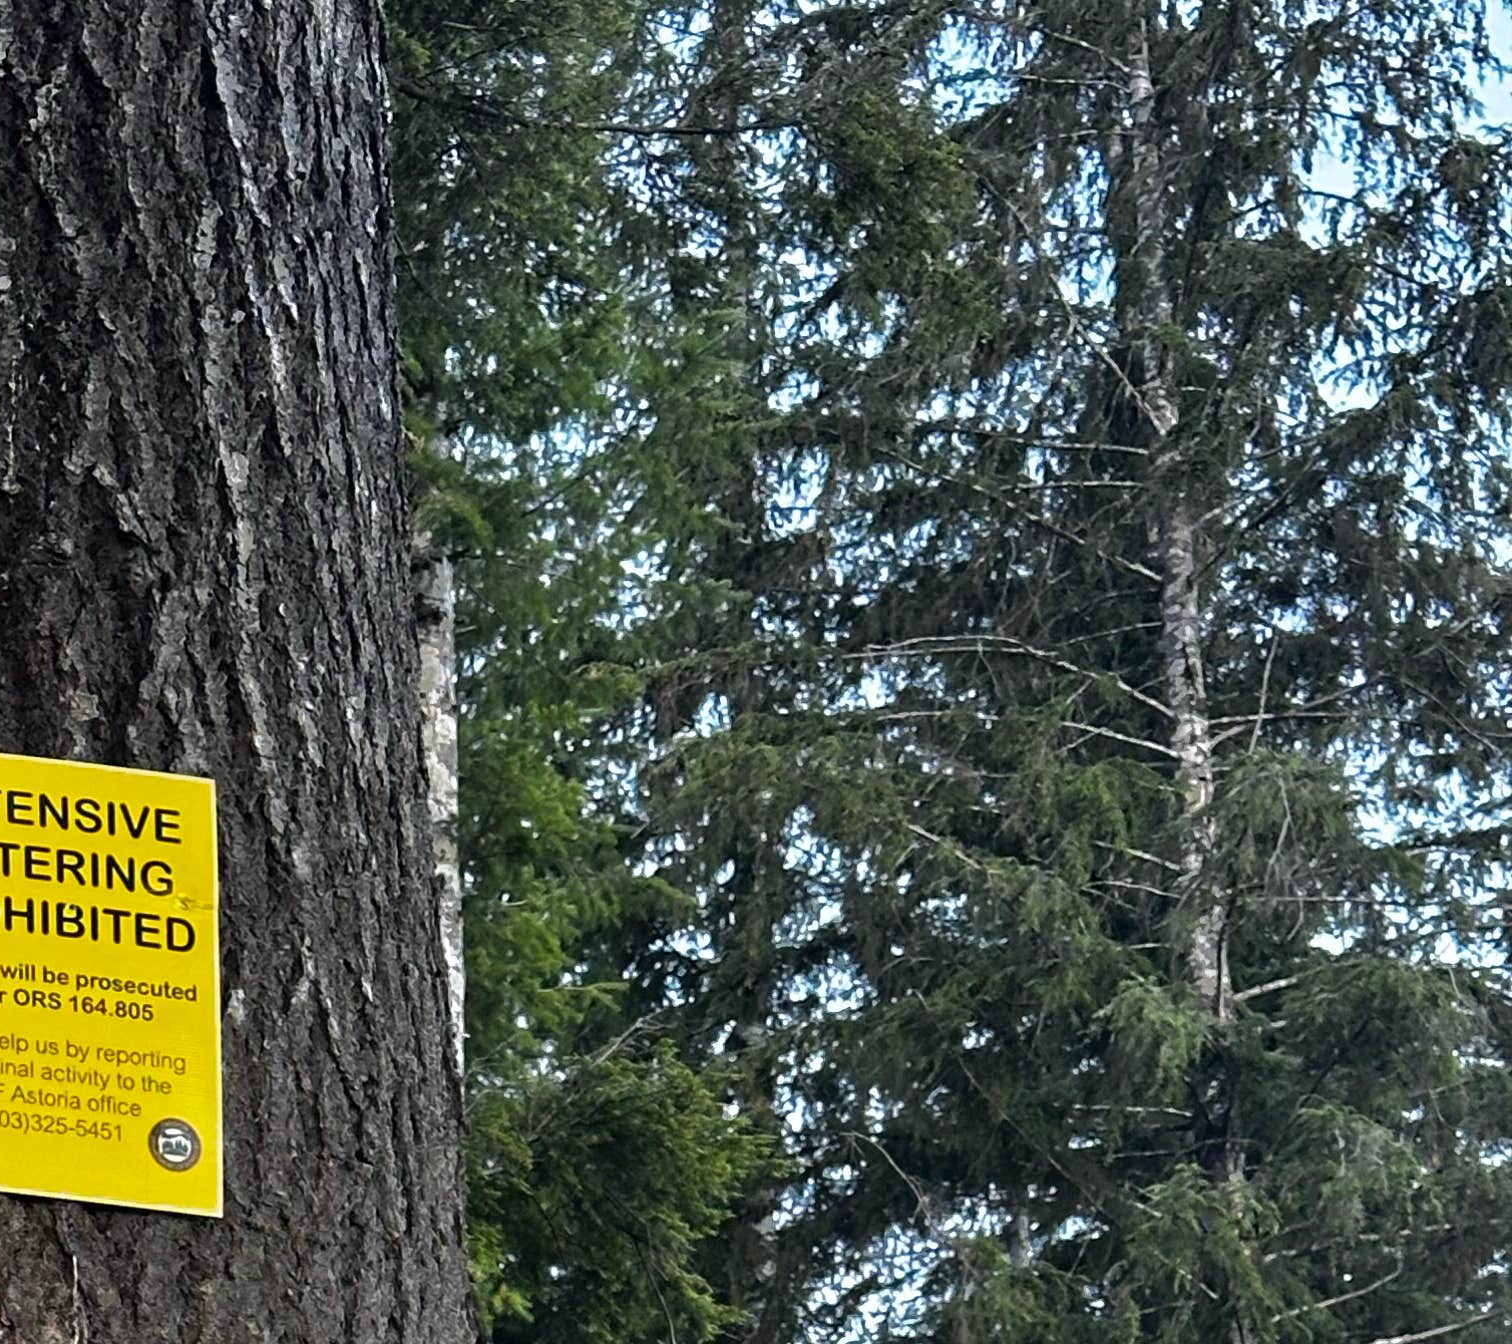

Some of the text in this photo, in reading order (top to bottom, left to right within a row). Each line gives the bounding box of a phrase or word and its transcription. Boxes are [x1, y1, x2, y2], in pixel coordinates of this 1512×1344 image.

[0, 965, 35, 982] will
[43, 968, 69, 986] be
[76, 973, 197, 1001] prosecuted
[14, 990, 61, 1010] ORS
[69, 996, 154, 1021] 164.805
[37, 1040, 59, 1055] us
[66, 1040, 89, 1063] by
[96, 1045, 186, 1075] reporting
[42, 1064, 110, 1091] activity
[117, 1073, 134, 1089] to
[141, 1075, 172, 1094] the
[11, 1085, 81, 1111] Astoria
[88, 1095, 141, 1117] office
